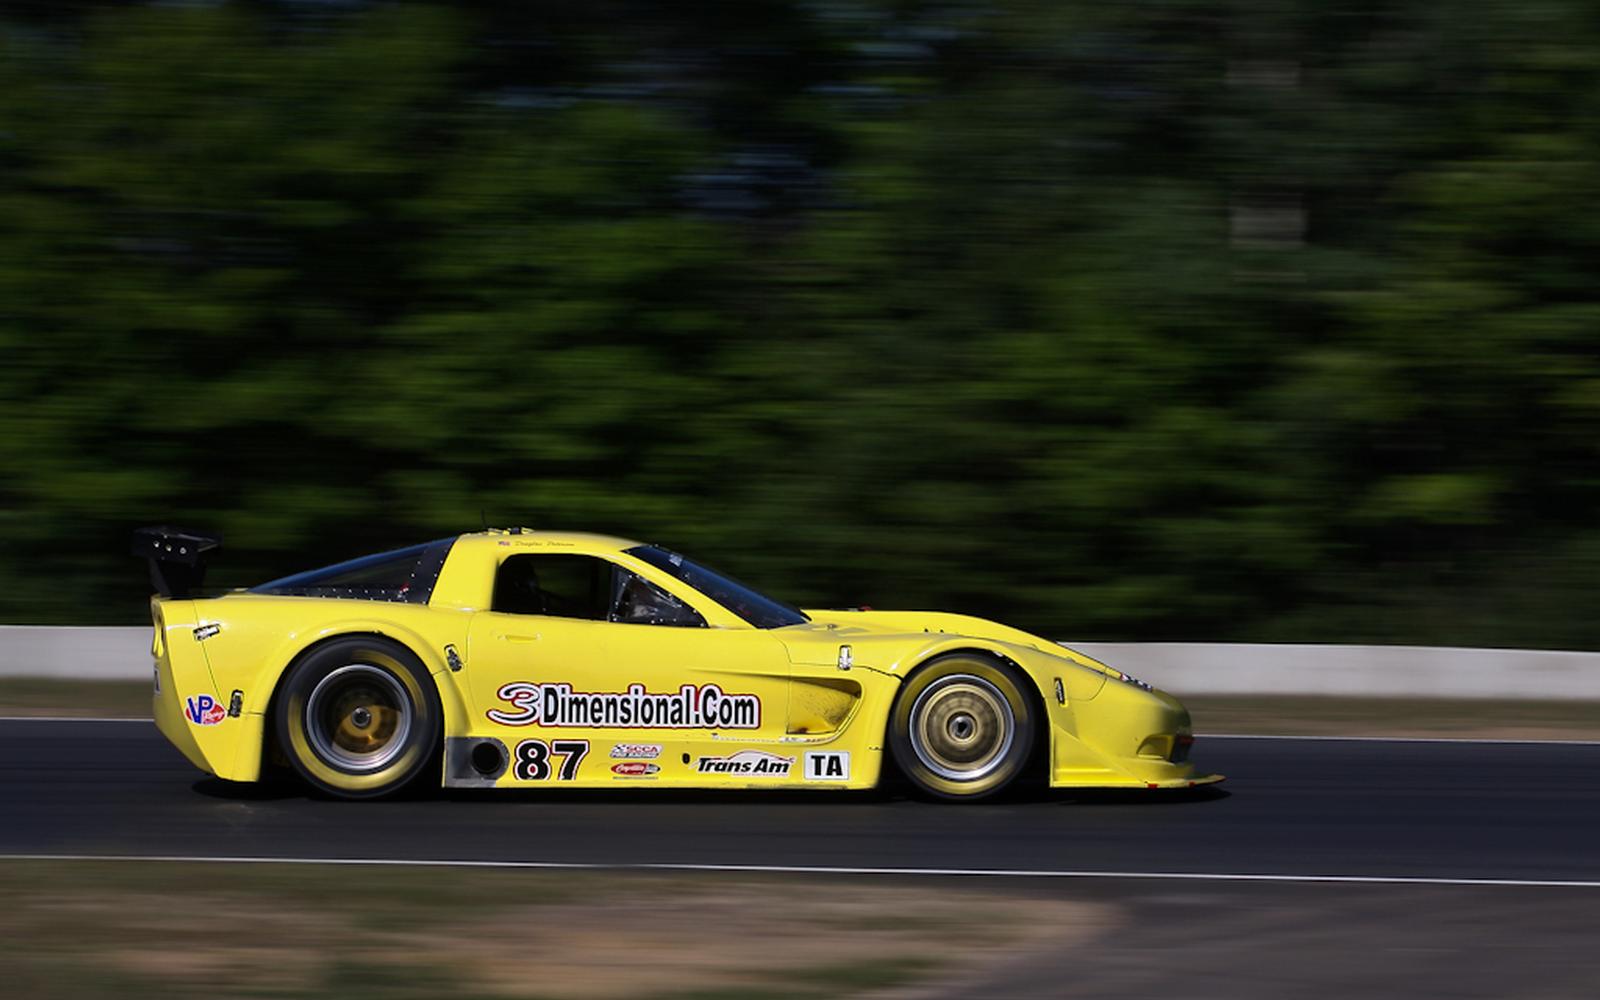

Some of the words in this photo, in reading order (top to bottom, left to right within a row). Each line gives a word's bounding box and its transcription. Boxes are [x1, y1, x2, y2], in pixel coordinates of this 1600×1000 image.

[187, 695, 214, 724] VP
[515, 741, 588, 780] 87
[698, 757, 751, 773] Trans
[753, 758, 790, 773] Am
[811, 755, 843, 776] TA
